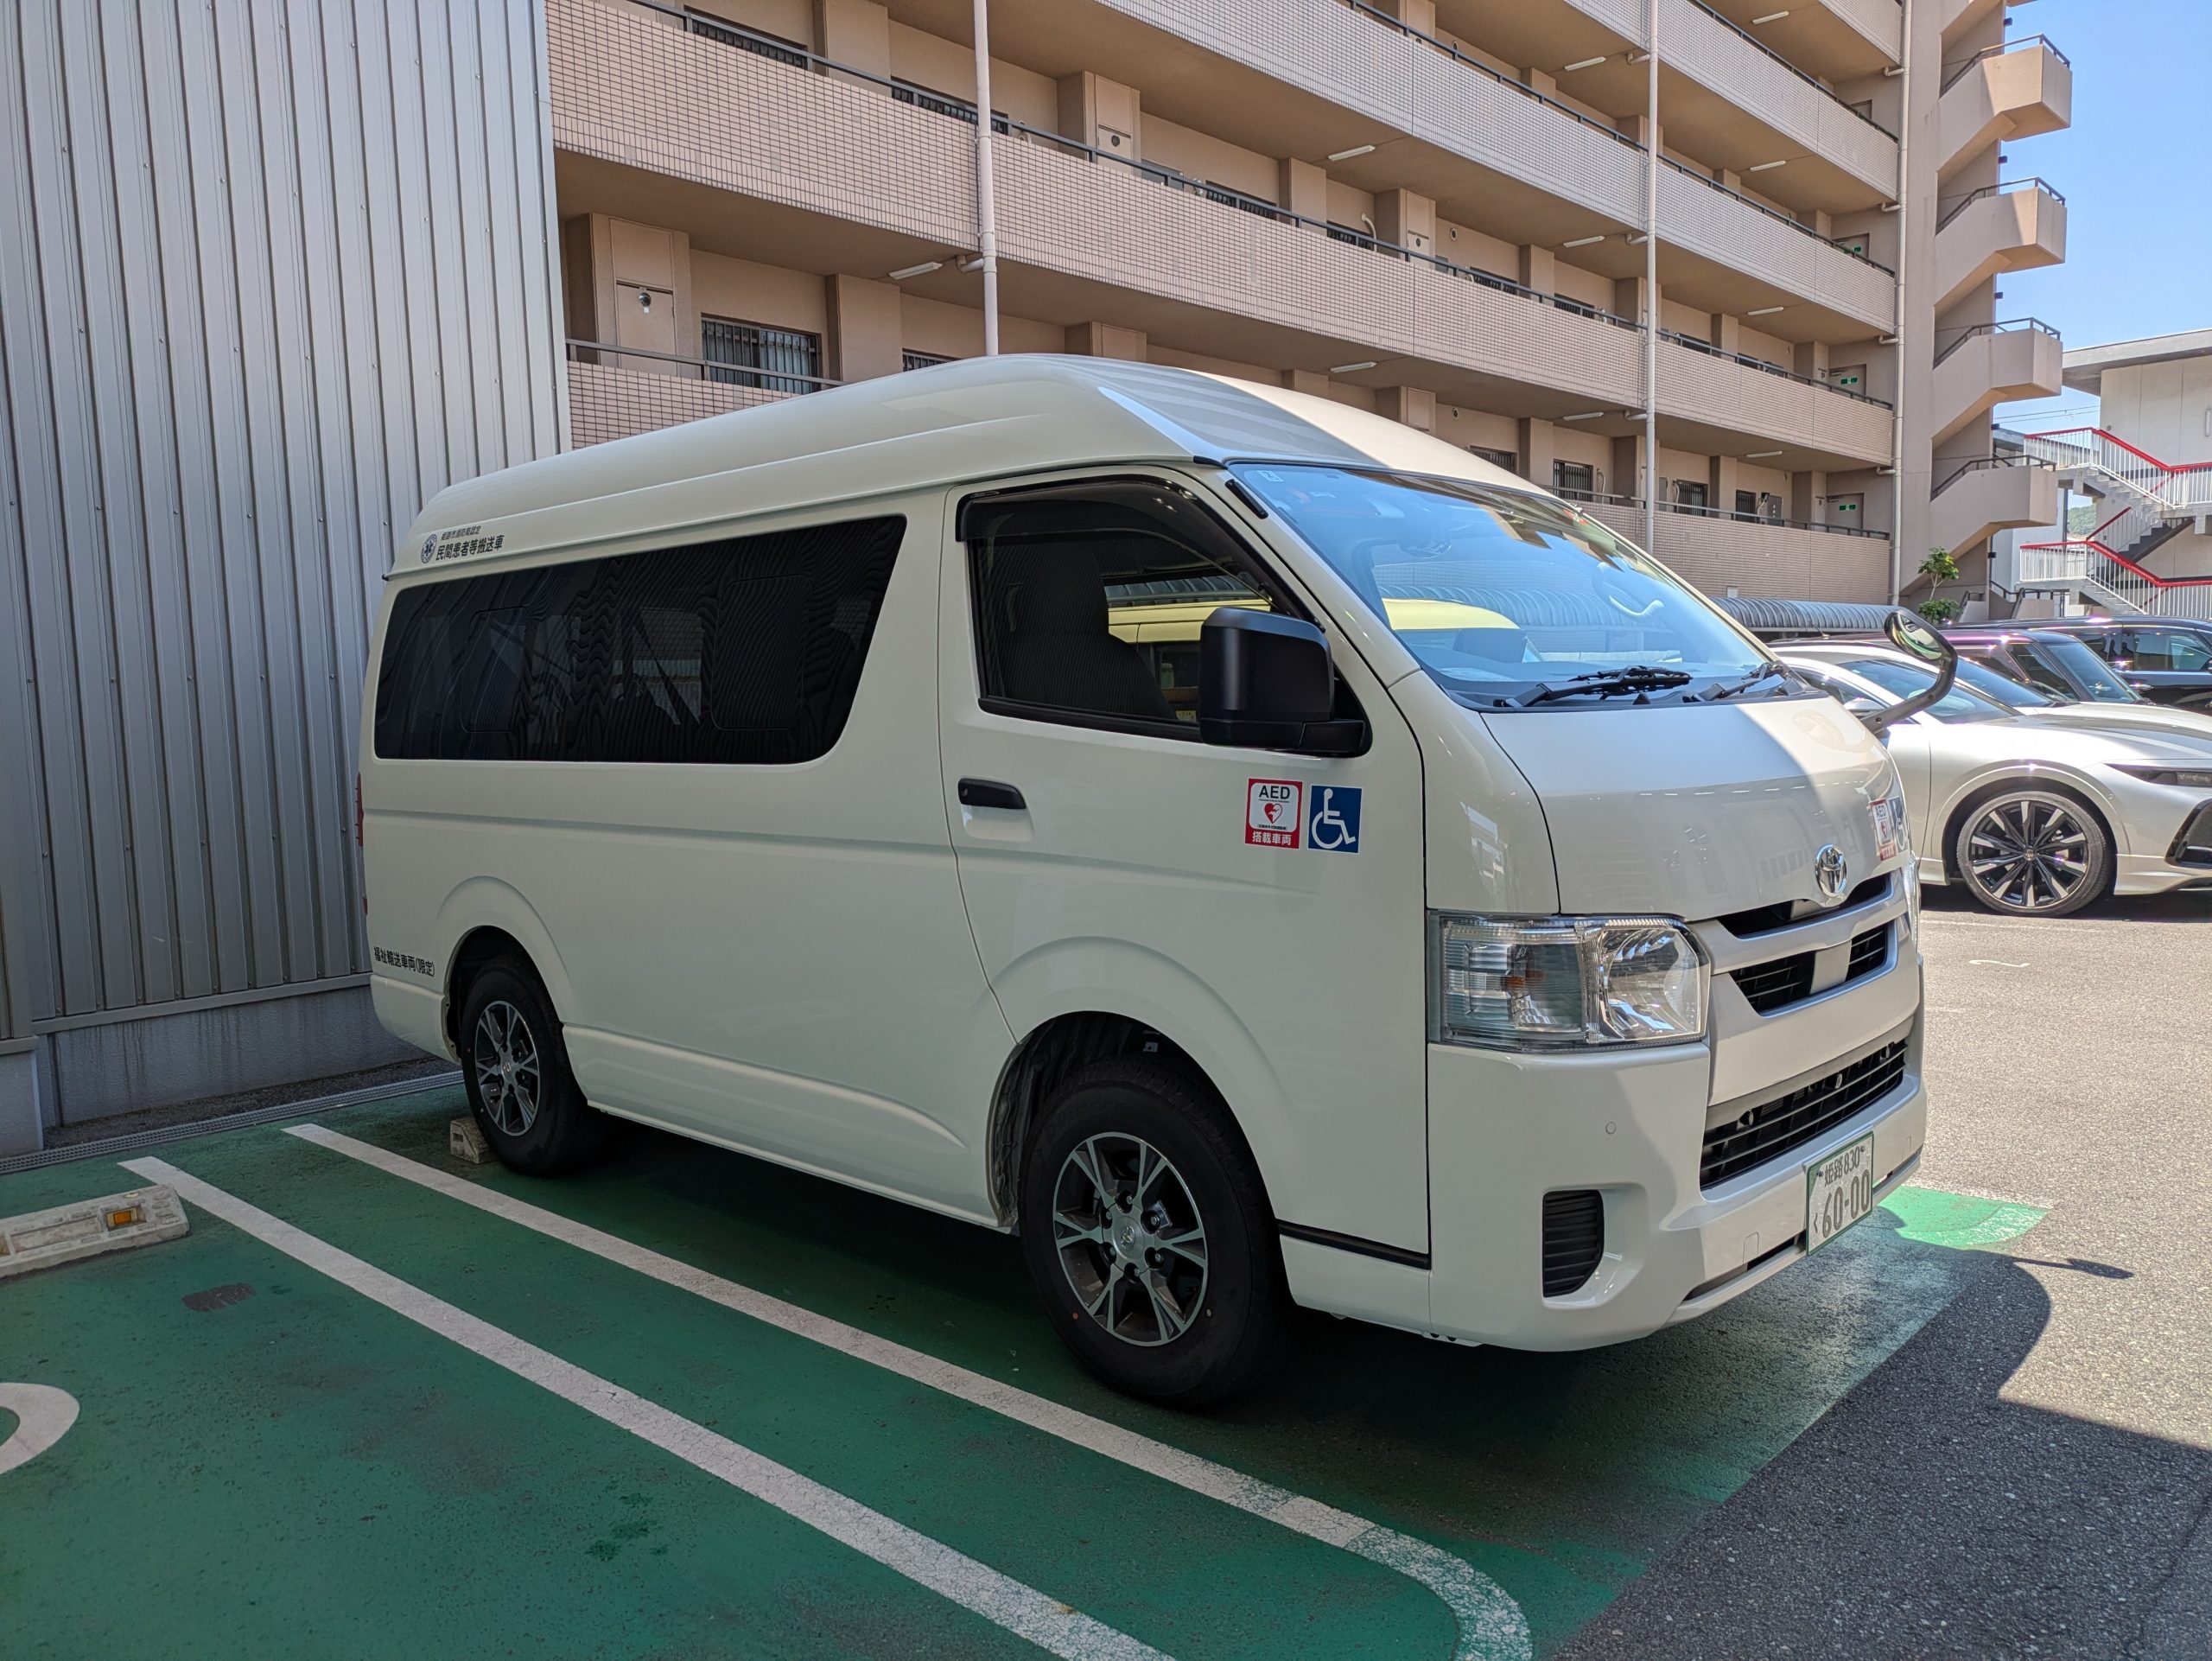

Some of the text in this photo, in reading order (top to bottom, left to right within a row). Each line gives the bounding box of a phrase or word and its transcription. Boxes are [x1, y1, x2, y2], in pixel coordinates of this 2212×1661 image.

[435, 534, 505, 561] 民間患者等搬送車
[1258, 785, 1291, 799] AED
[1252, 830, 1292, 846] 搭載車両
[1813, 1168, 1871, 1238] く 60-00
